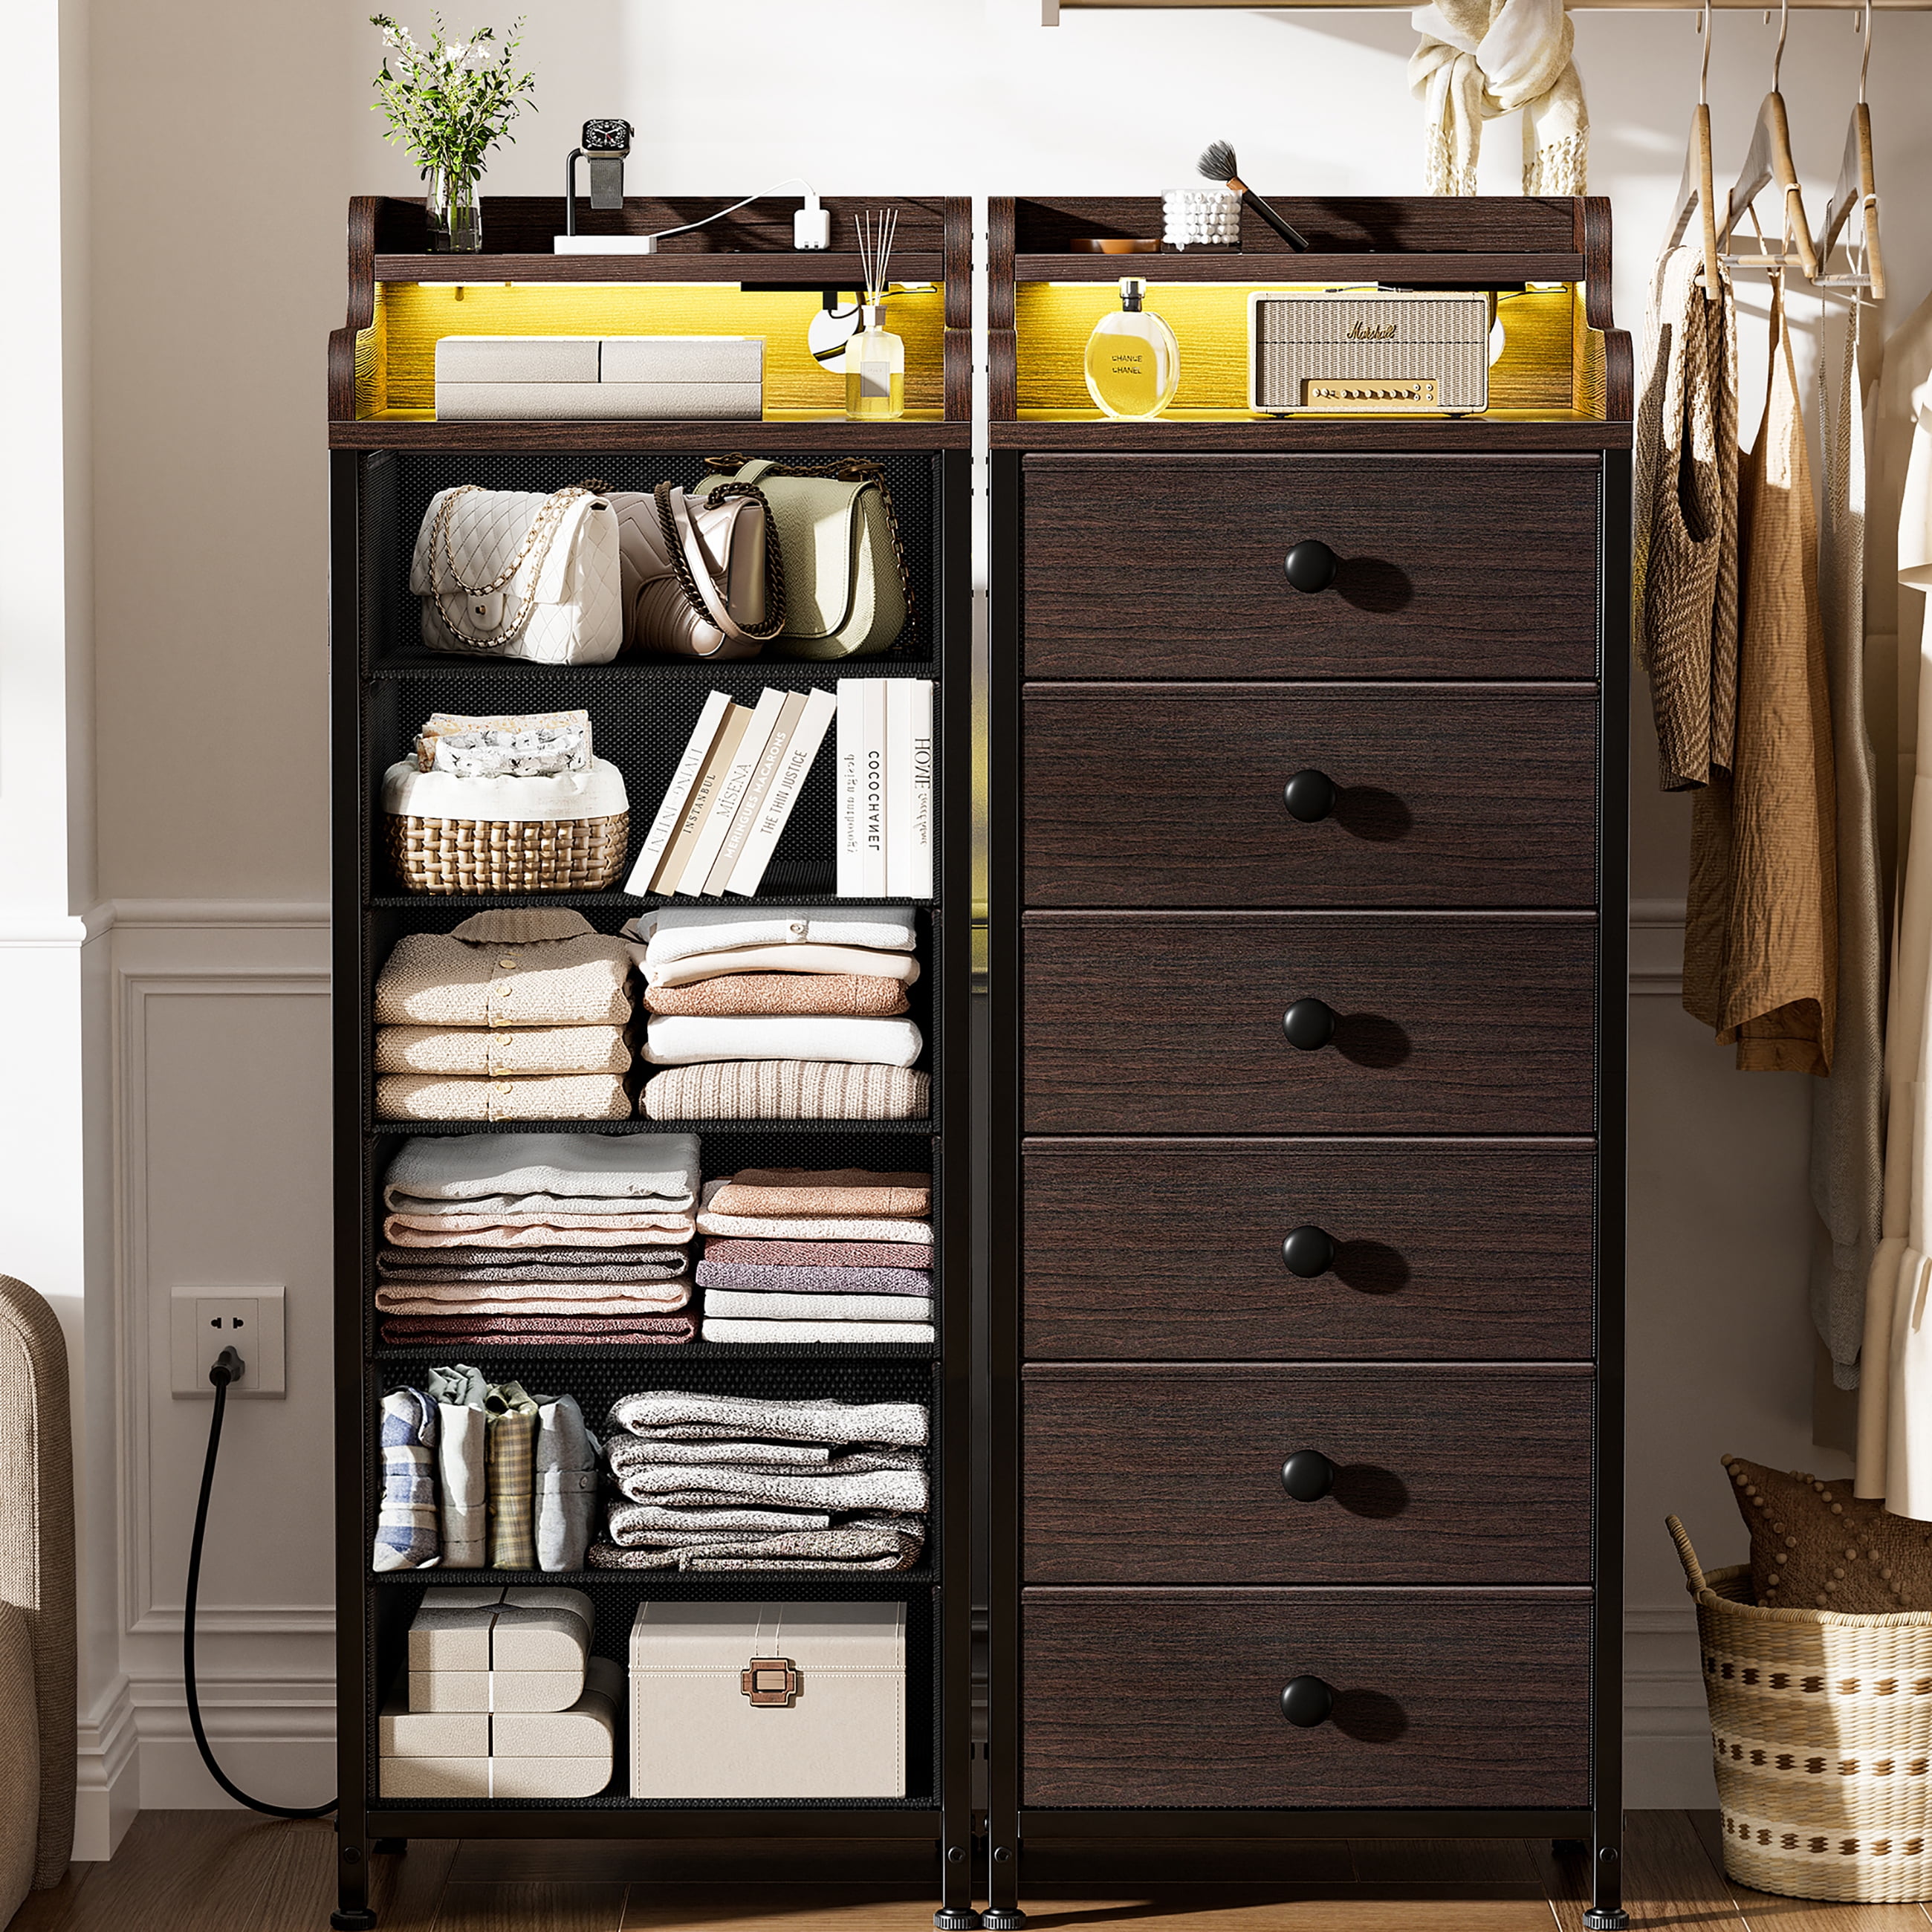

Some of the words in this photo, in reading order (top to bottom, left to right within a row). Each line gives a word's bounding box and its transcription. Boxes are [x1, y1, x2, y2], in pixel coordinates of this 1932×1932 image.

[1346, 320, 1397, 340] Marshall
[781, 750, 808, 789] JUSTICE
[683, 774, 716, 834] INSTANBUL
[724, 795, 759, 859] MERINGUES
[753, 731, 786, 793] MACARONS
[769, 790, 789, 814] THIN
[760, 816, 779, 834] THE
